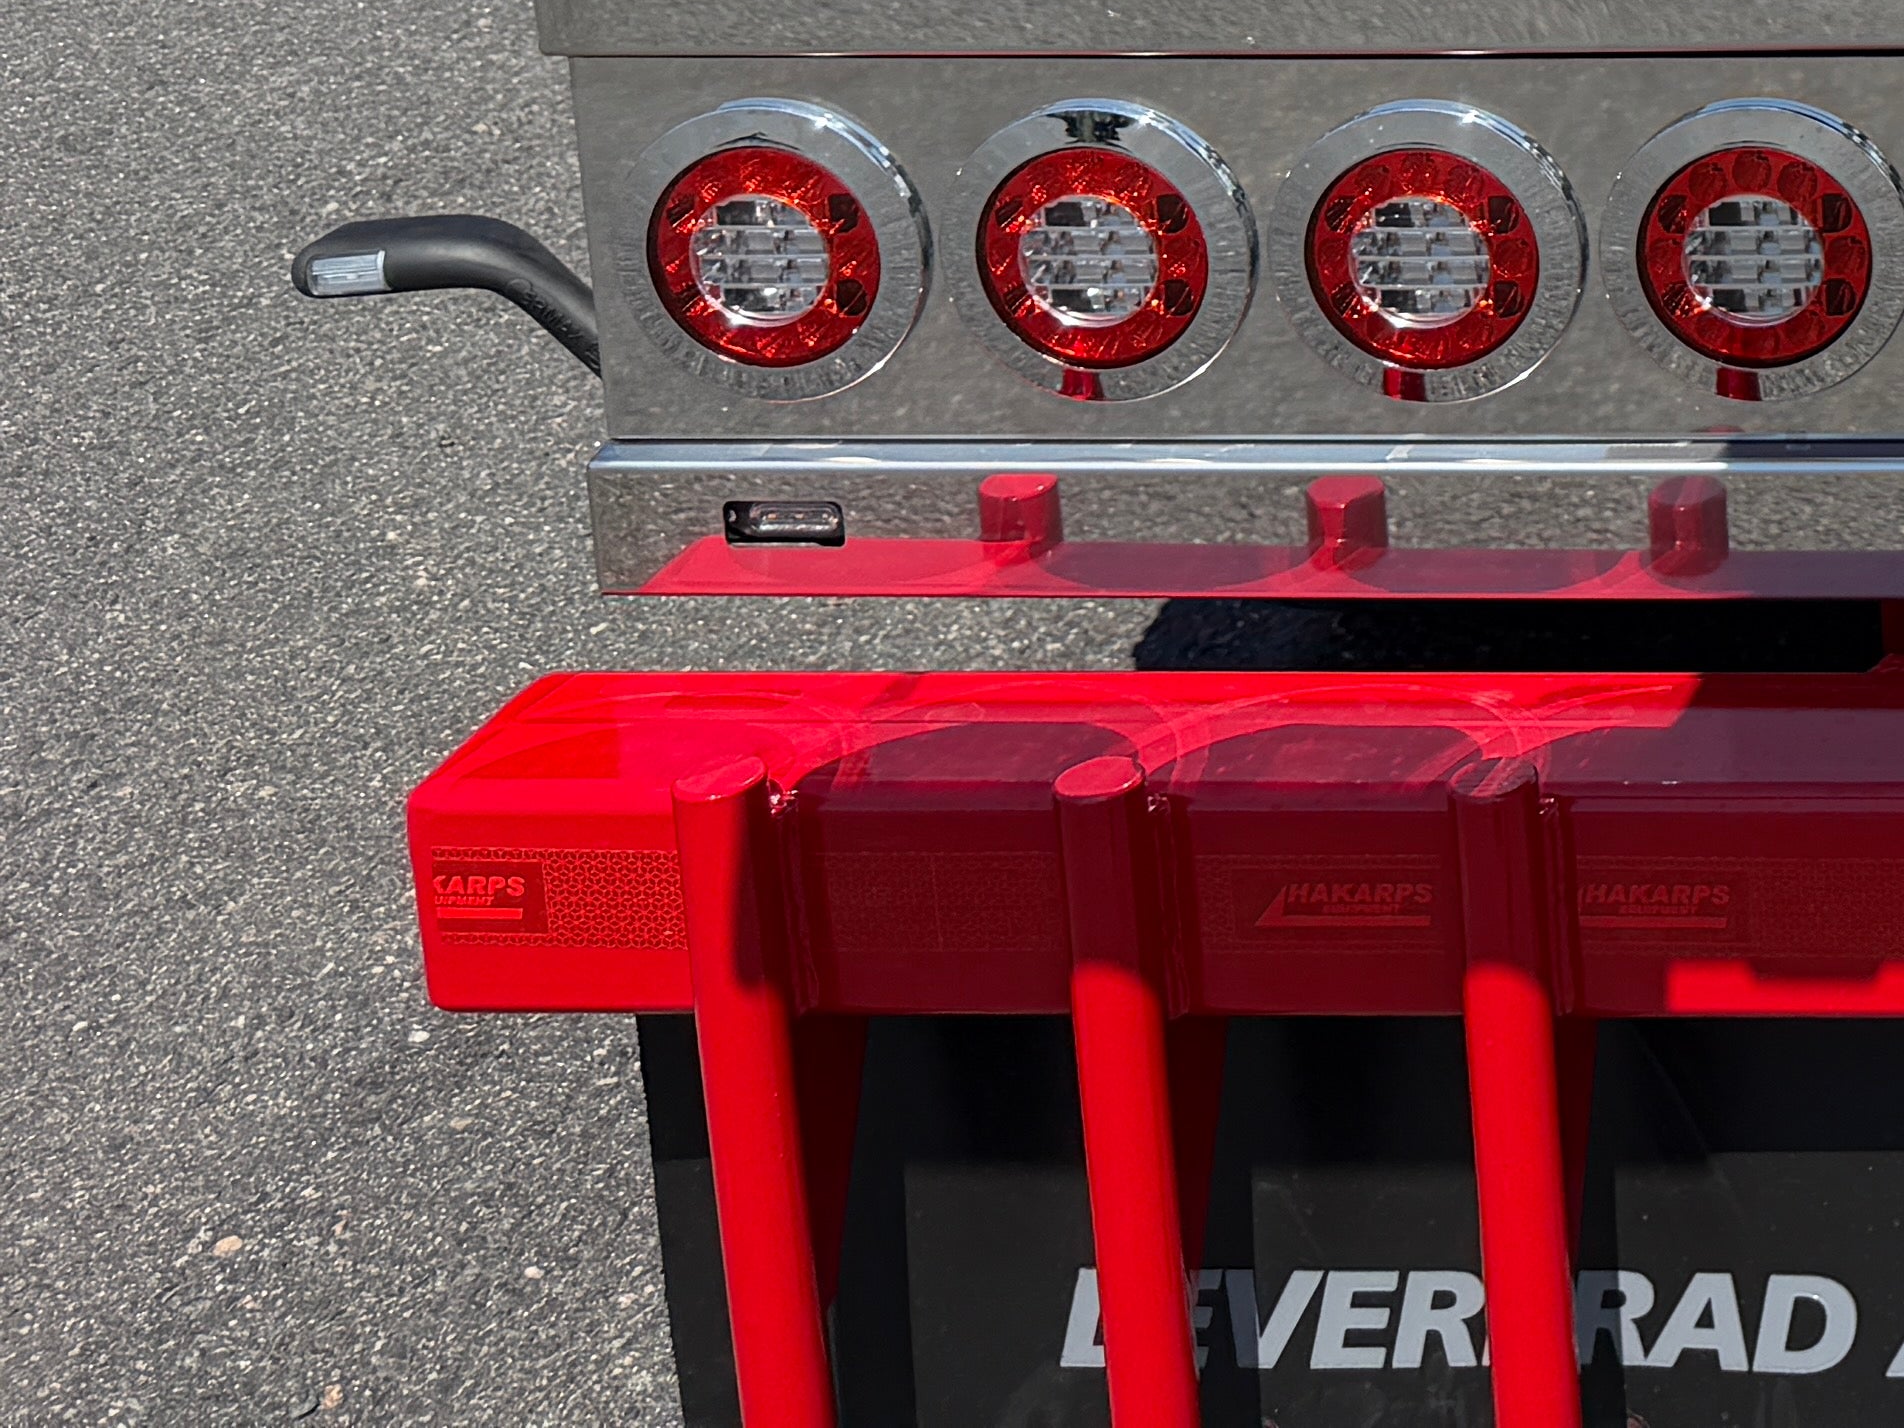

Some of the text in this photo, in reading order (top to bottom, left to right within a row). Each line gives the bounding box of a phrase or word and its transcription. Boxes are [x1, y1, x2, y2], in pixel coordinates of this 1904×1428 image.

[1287, 883, 1433, 905] HAKARPS
[1586, 884, 1730, 906] HAKARPS
[1060, 1267, 1859, 1375] LVERRAD
